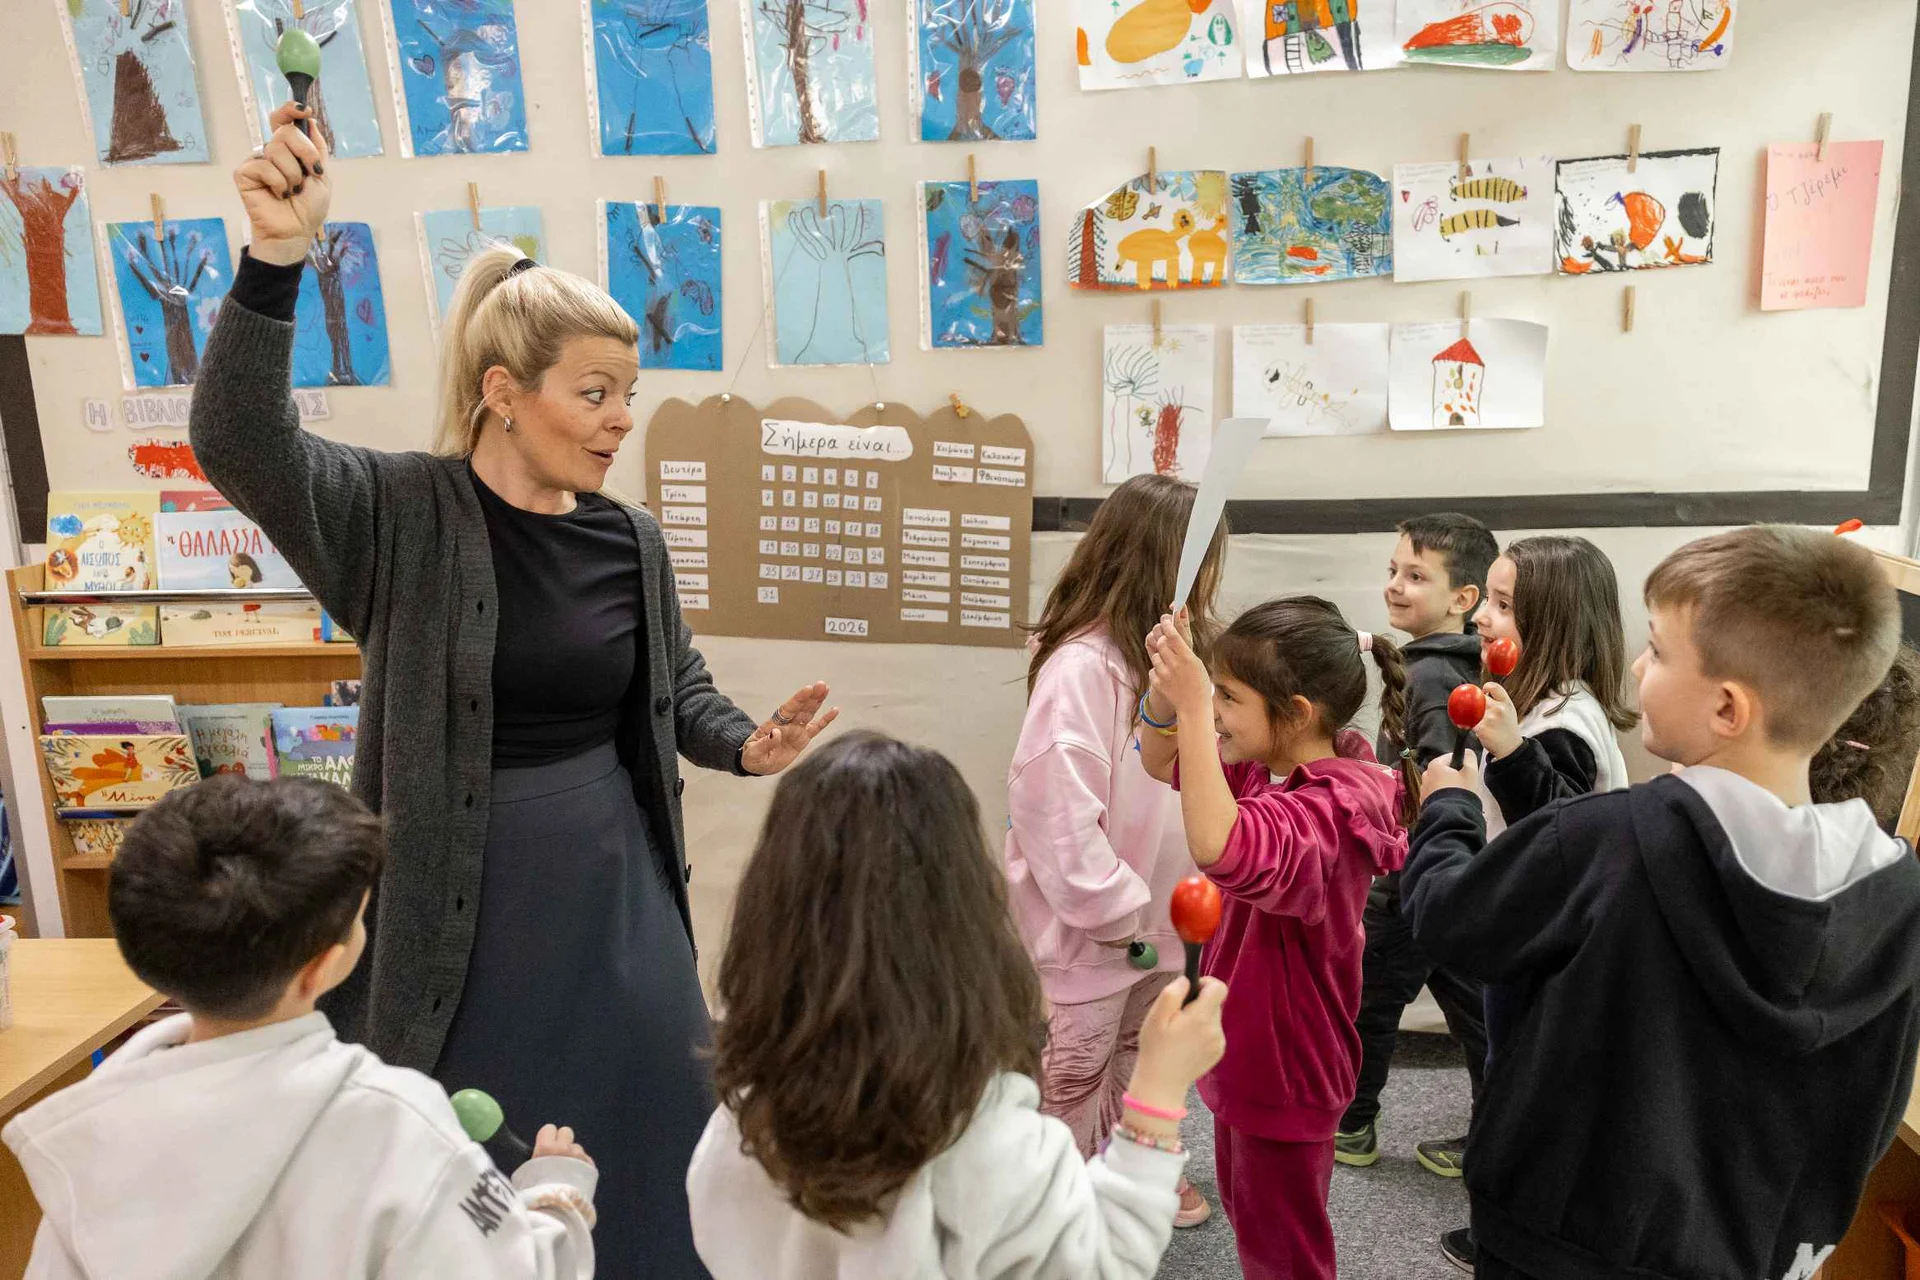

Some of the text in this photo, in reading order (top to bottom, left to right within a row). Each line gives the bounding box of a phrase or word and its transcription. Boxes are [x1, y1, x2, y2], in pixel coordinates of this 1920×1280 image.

[88, 397, 191, 426] Η ΒΙΒΛΙΟ
[763, 422, 839, 455] Σήμερα
[663, 464, 703, 476] Δευτέρα
[826, 498, 836, 506] 10
[846, 499, 855, 507] 11
[764, 519, 775, 528] 13
[808, 520, 818, 529] 15
[827, 523, 837, 532] 16
[849, 524, 859, 533] 17
[869, 526, 879, 535] 18
[179, 528, 264, 557] ΘΑΛΑΣΣΑ
[81, 552, 121, 567] ΑΙΣΩΠΟΣ
[765, 542, 882, 561] 19 20 21 22 23 24
[765, 566, 777, 577] 25
[785, 567, 797, 577] 26
[807, 569, 820, 580] 27
[849, 574, 862, 584] 29
[873, 576, 886, 585] 30
[762, 590, 776, 600] 31
[828, 620, 866, 634] 2026
[325, 755, 354, 771] ΑΛΟ
